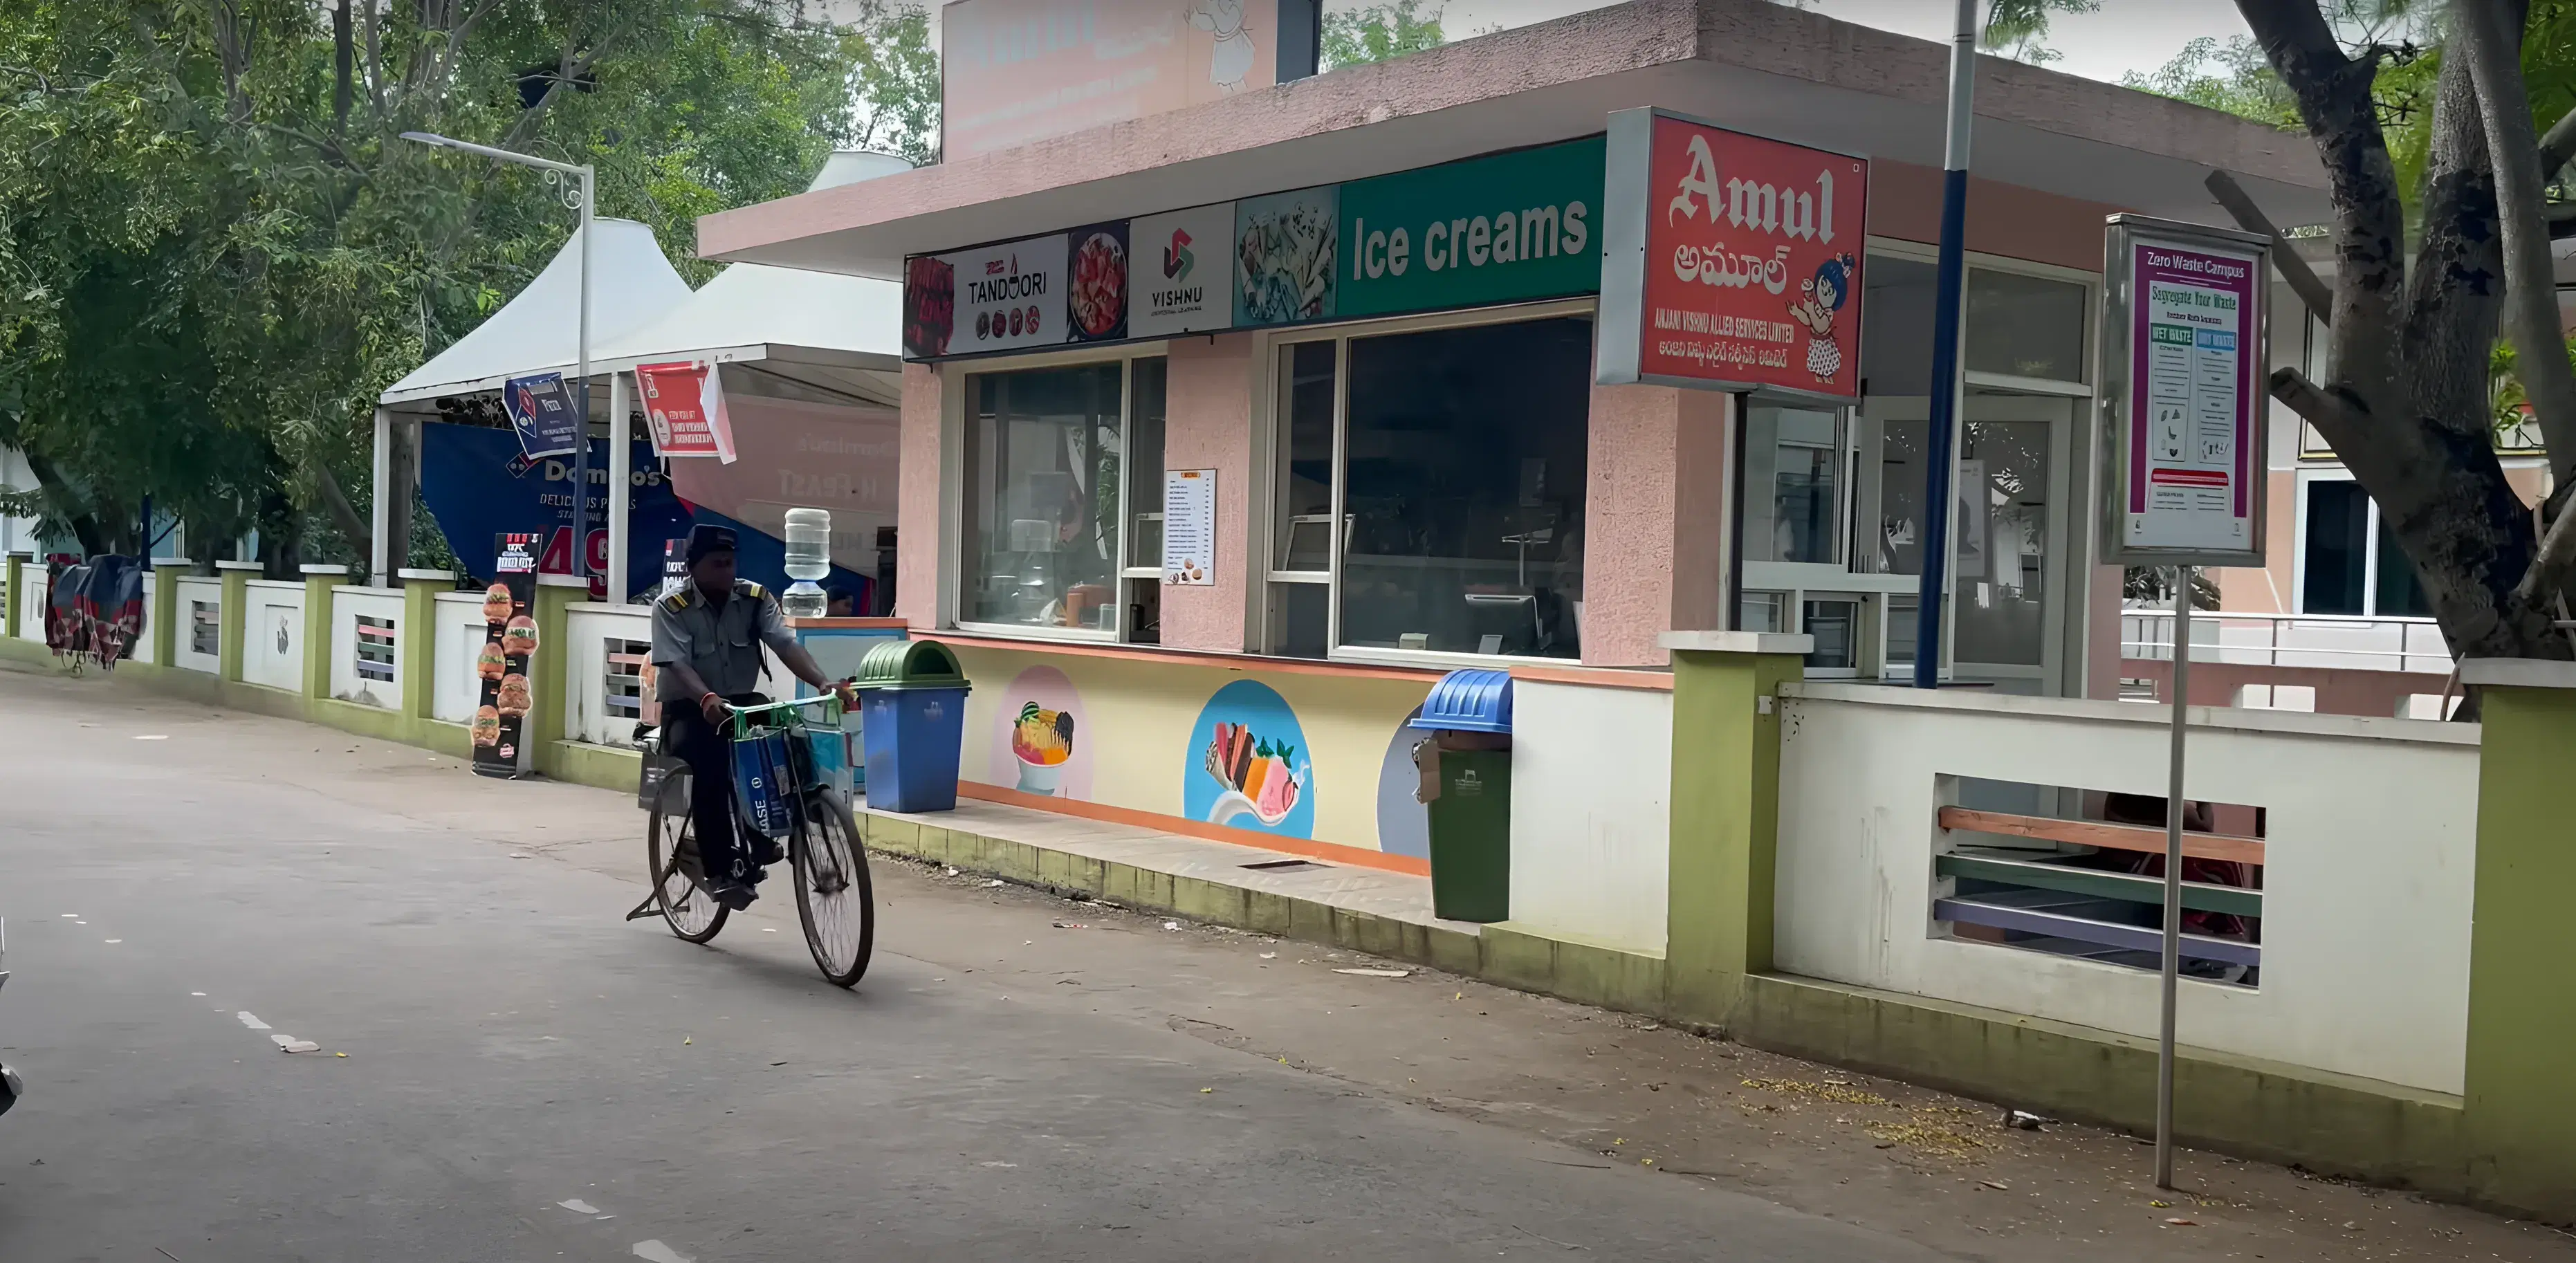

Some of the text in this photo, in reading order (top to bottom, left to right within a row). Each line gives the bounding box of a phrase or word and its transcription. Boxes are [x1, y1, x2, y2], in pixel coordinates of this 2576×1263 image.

[1669, 134, 1834, 245] Amul
[1354, 201, 1588, 280] Ice creams
[1674, 242, 1791, 295] అమూల్
[2148, 252, 2244, 279] Zero Waste Campus
[968, 271, 1046, 304] TANDOORI
[1152, 286, 1202, 307] VISHNU
[540, 493, 596, 509] DELICIUS
